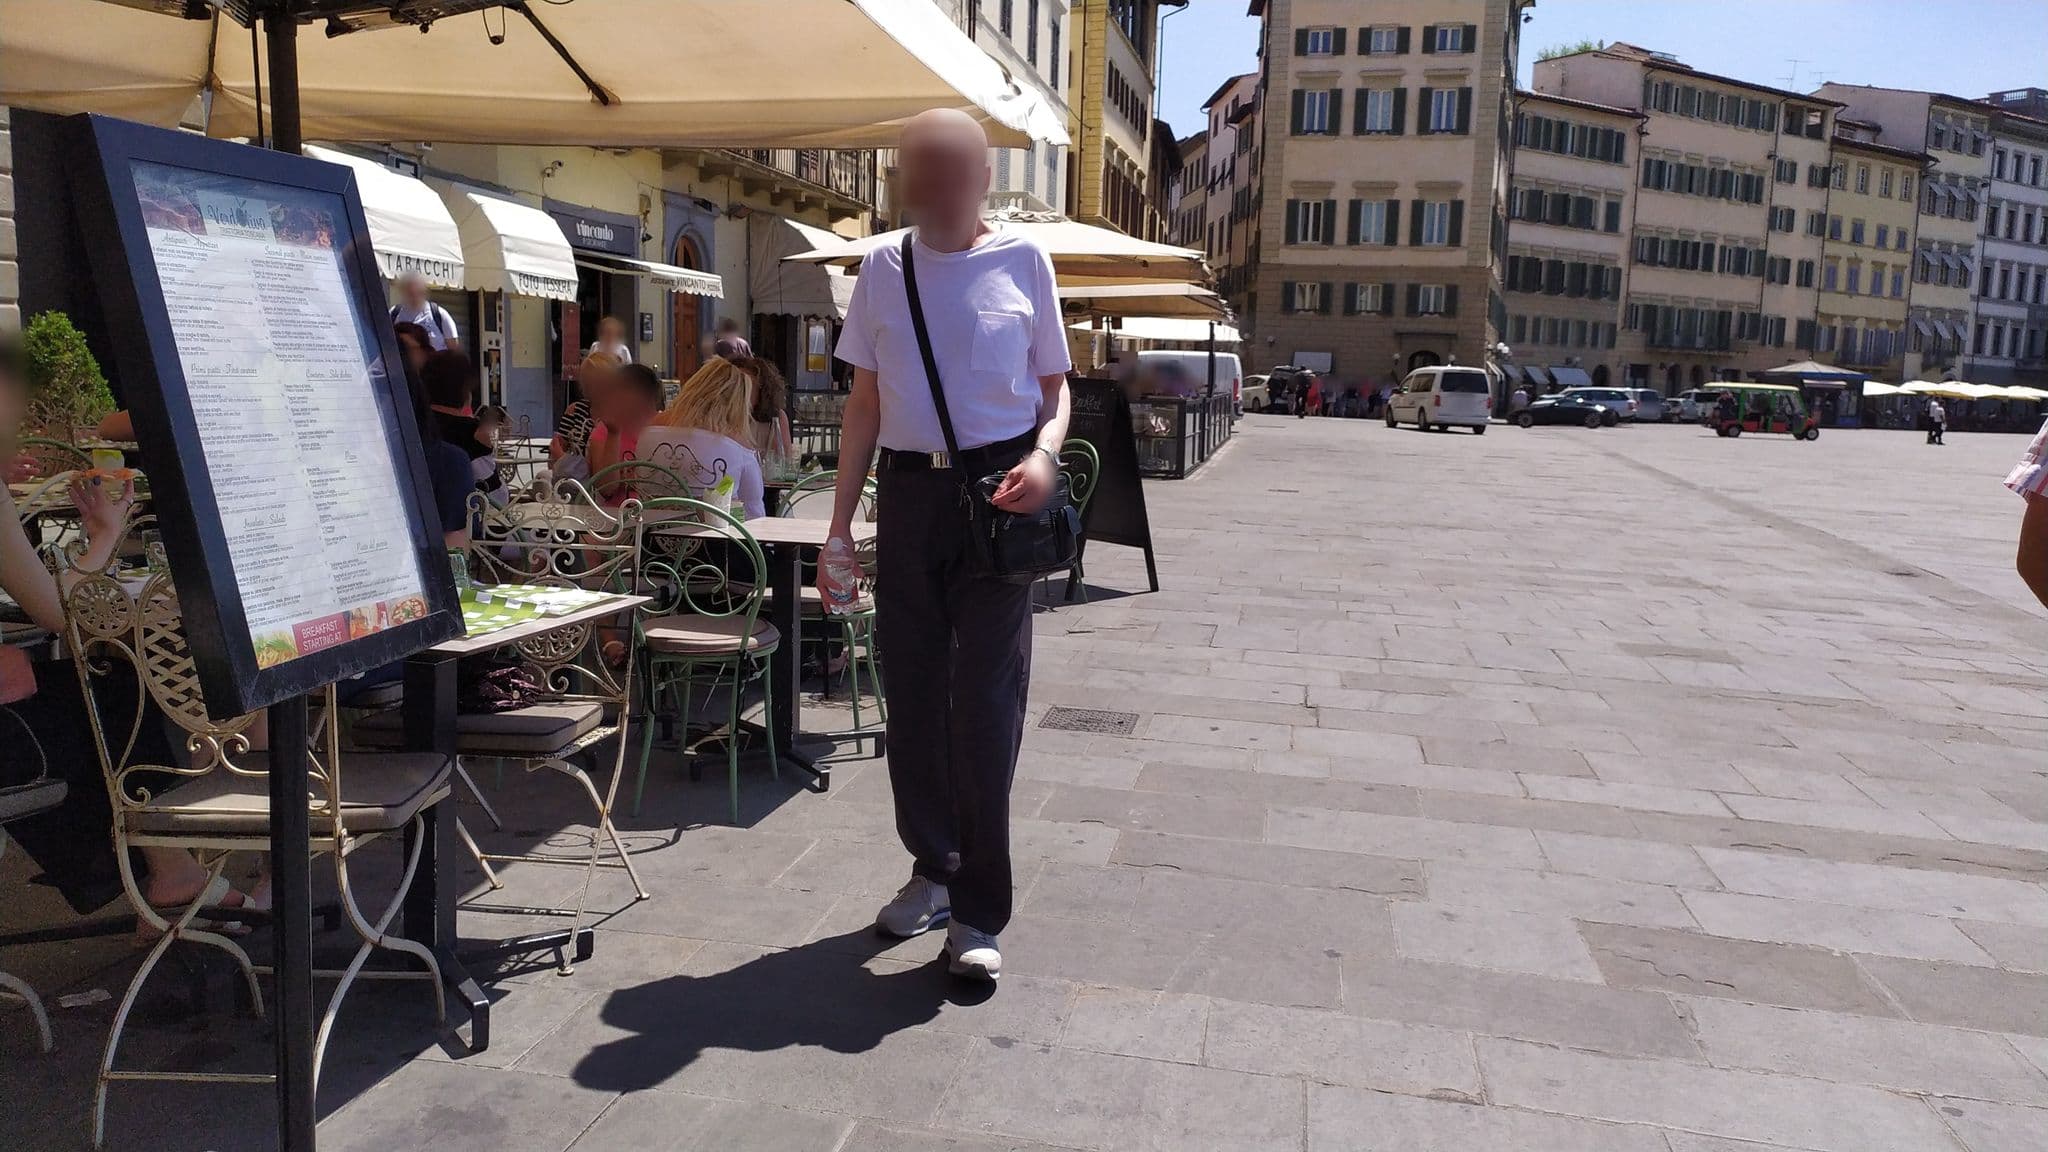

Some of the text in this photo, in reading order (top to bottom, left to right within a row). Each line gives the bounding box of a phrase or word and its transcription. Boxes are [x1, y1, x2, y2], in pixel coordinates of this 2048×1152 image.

[385, 253, 455, 280] TABACCHI
[518, 272, 572, 294] FOTO TESSERA
[675, 276, 706, 290] VINCANTO
[301, 620, 339, 639] BREAKFAST
[303, 632, 342, 651] STARTING AT
